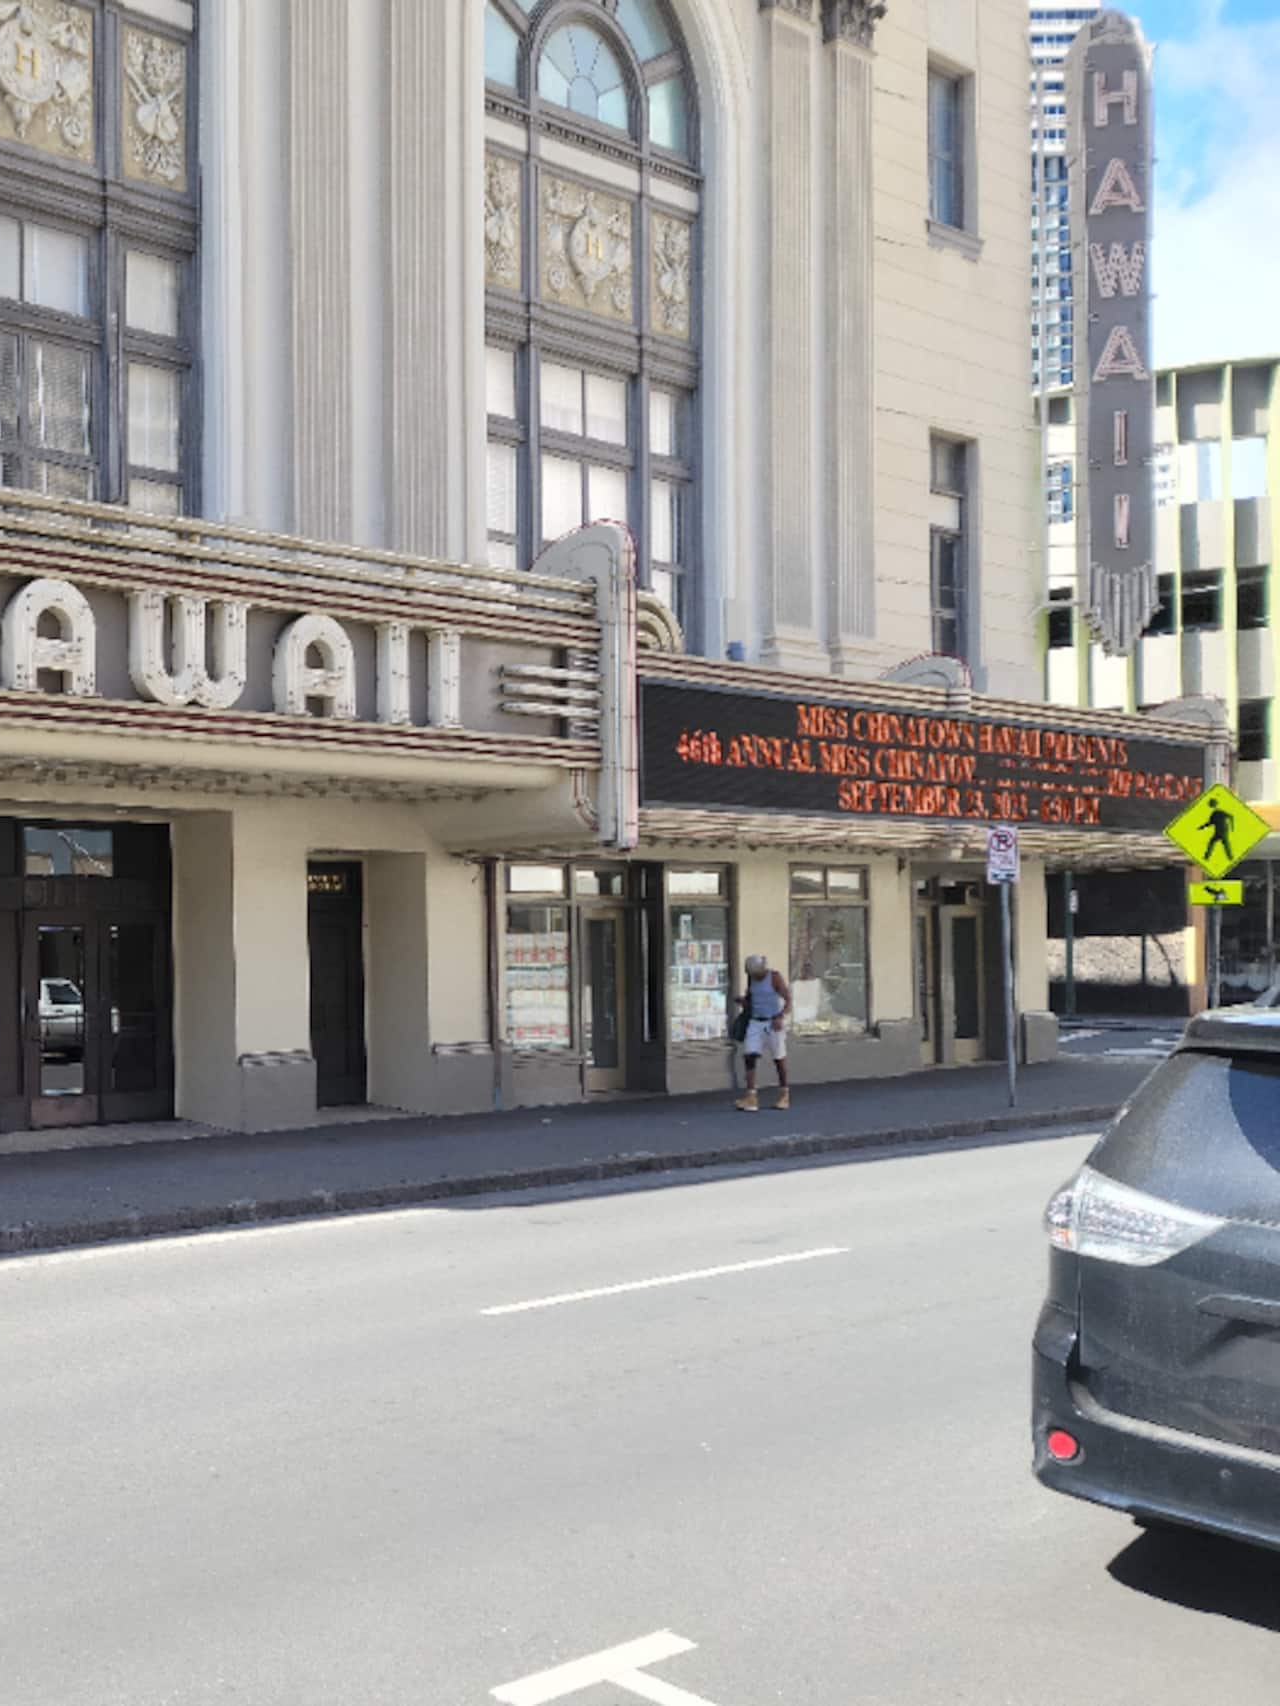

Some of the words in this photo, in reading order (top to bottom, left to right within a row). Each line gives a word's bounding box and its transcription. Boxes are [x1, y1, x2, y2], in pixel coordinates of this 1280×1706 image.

[1089, 69, 1148, 549] HAWAII
[675, 728, 723, 765] 46th
[725, 734, 817, 773] ANNUAL
[818, 741, 870, 777] MISS
[796, 703, 848, 739] MISS
[853, 710, 975, 750] CHINATOWN
[979, 723, 1041, 759] HAWAII
[1043, 730, 1128, 765] PRESENTS
[838, 779, 961, 817] SEPTEMBER
[991, 791, 1027, 821] 2023
[1074, 796, 1101, 825] PM
